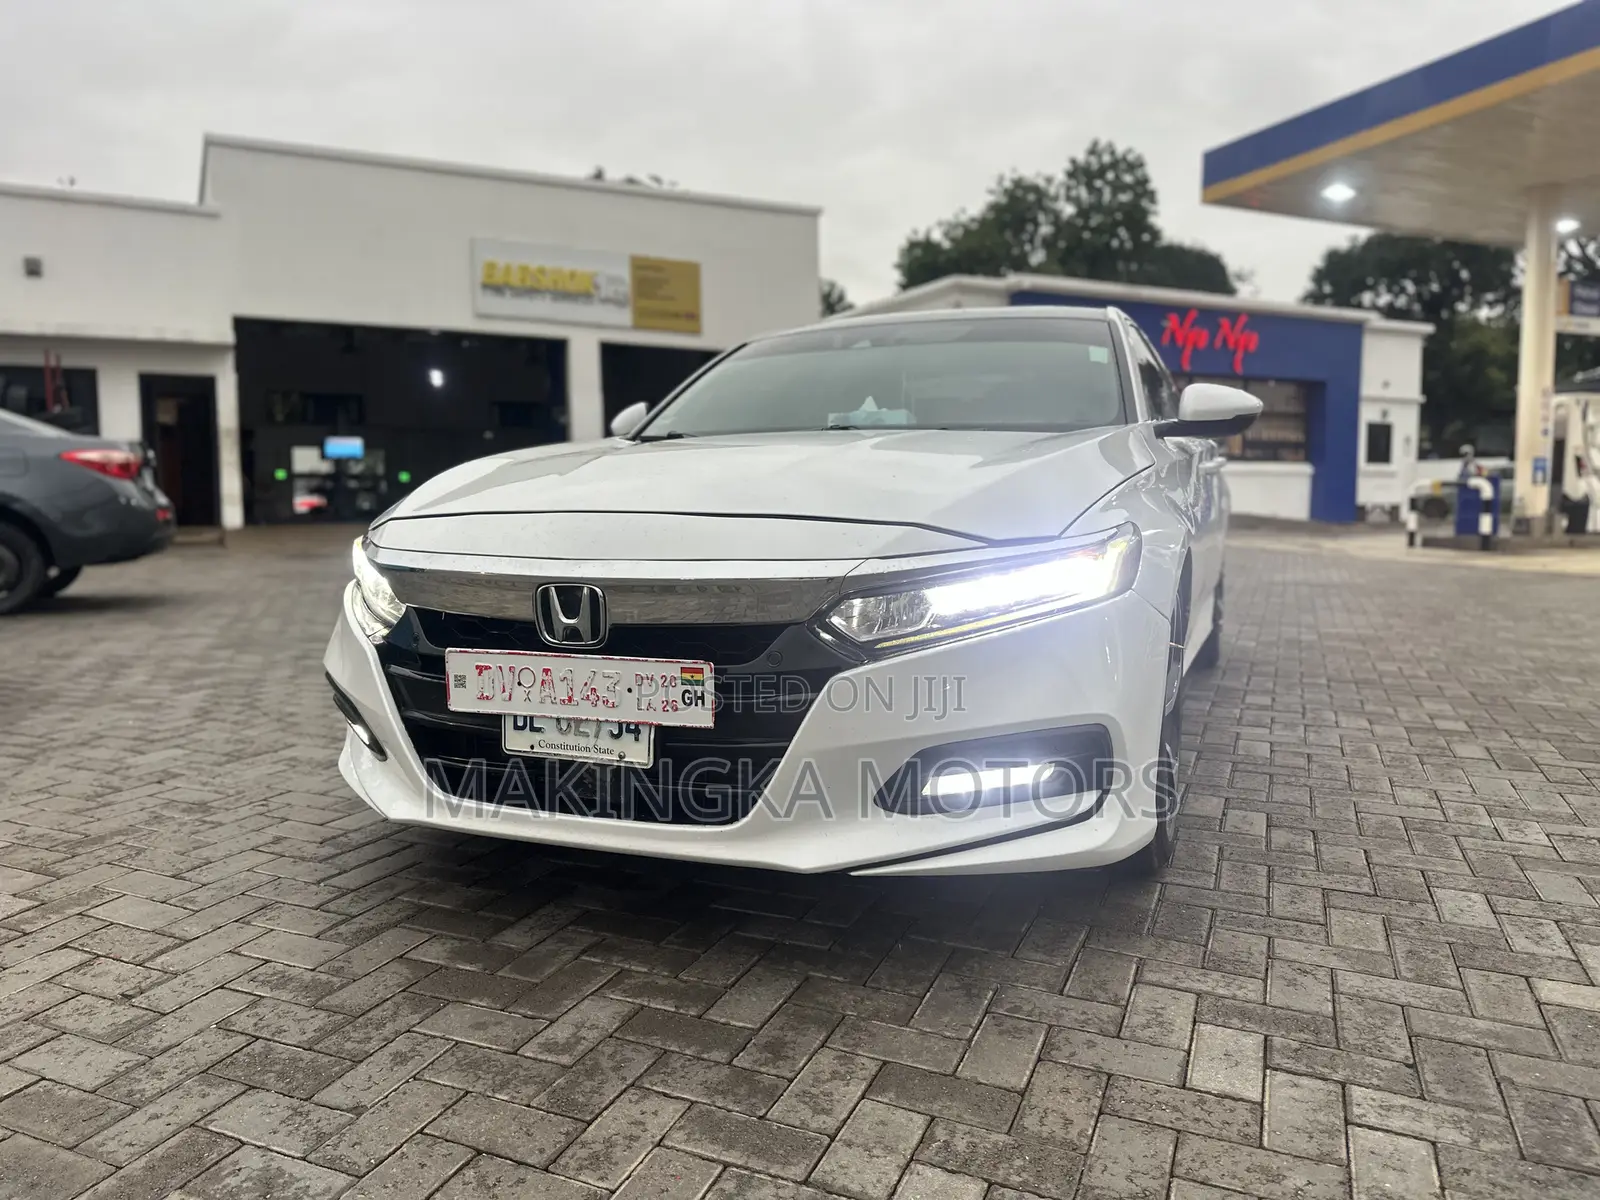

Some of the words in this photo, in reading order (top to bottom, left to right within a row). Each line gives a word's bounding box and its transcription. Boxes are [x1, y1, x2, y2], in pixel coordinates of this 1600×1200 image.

[681, 689, 706, 707] GH
[538, 739, 592, 753] Constitution
[593, 745, 615, 755] State
